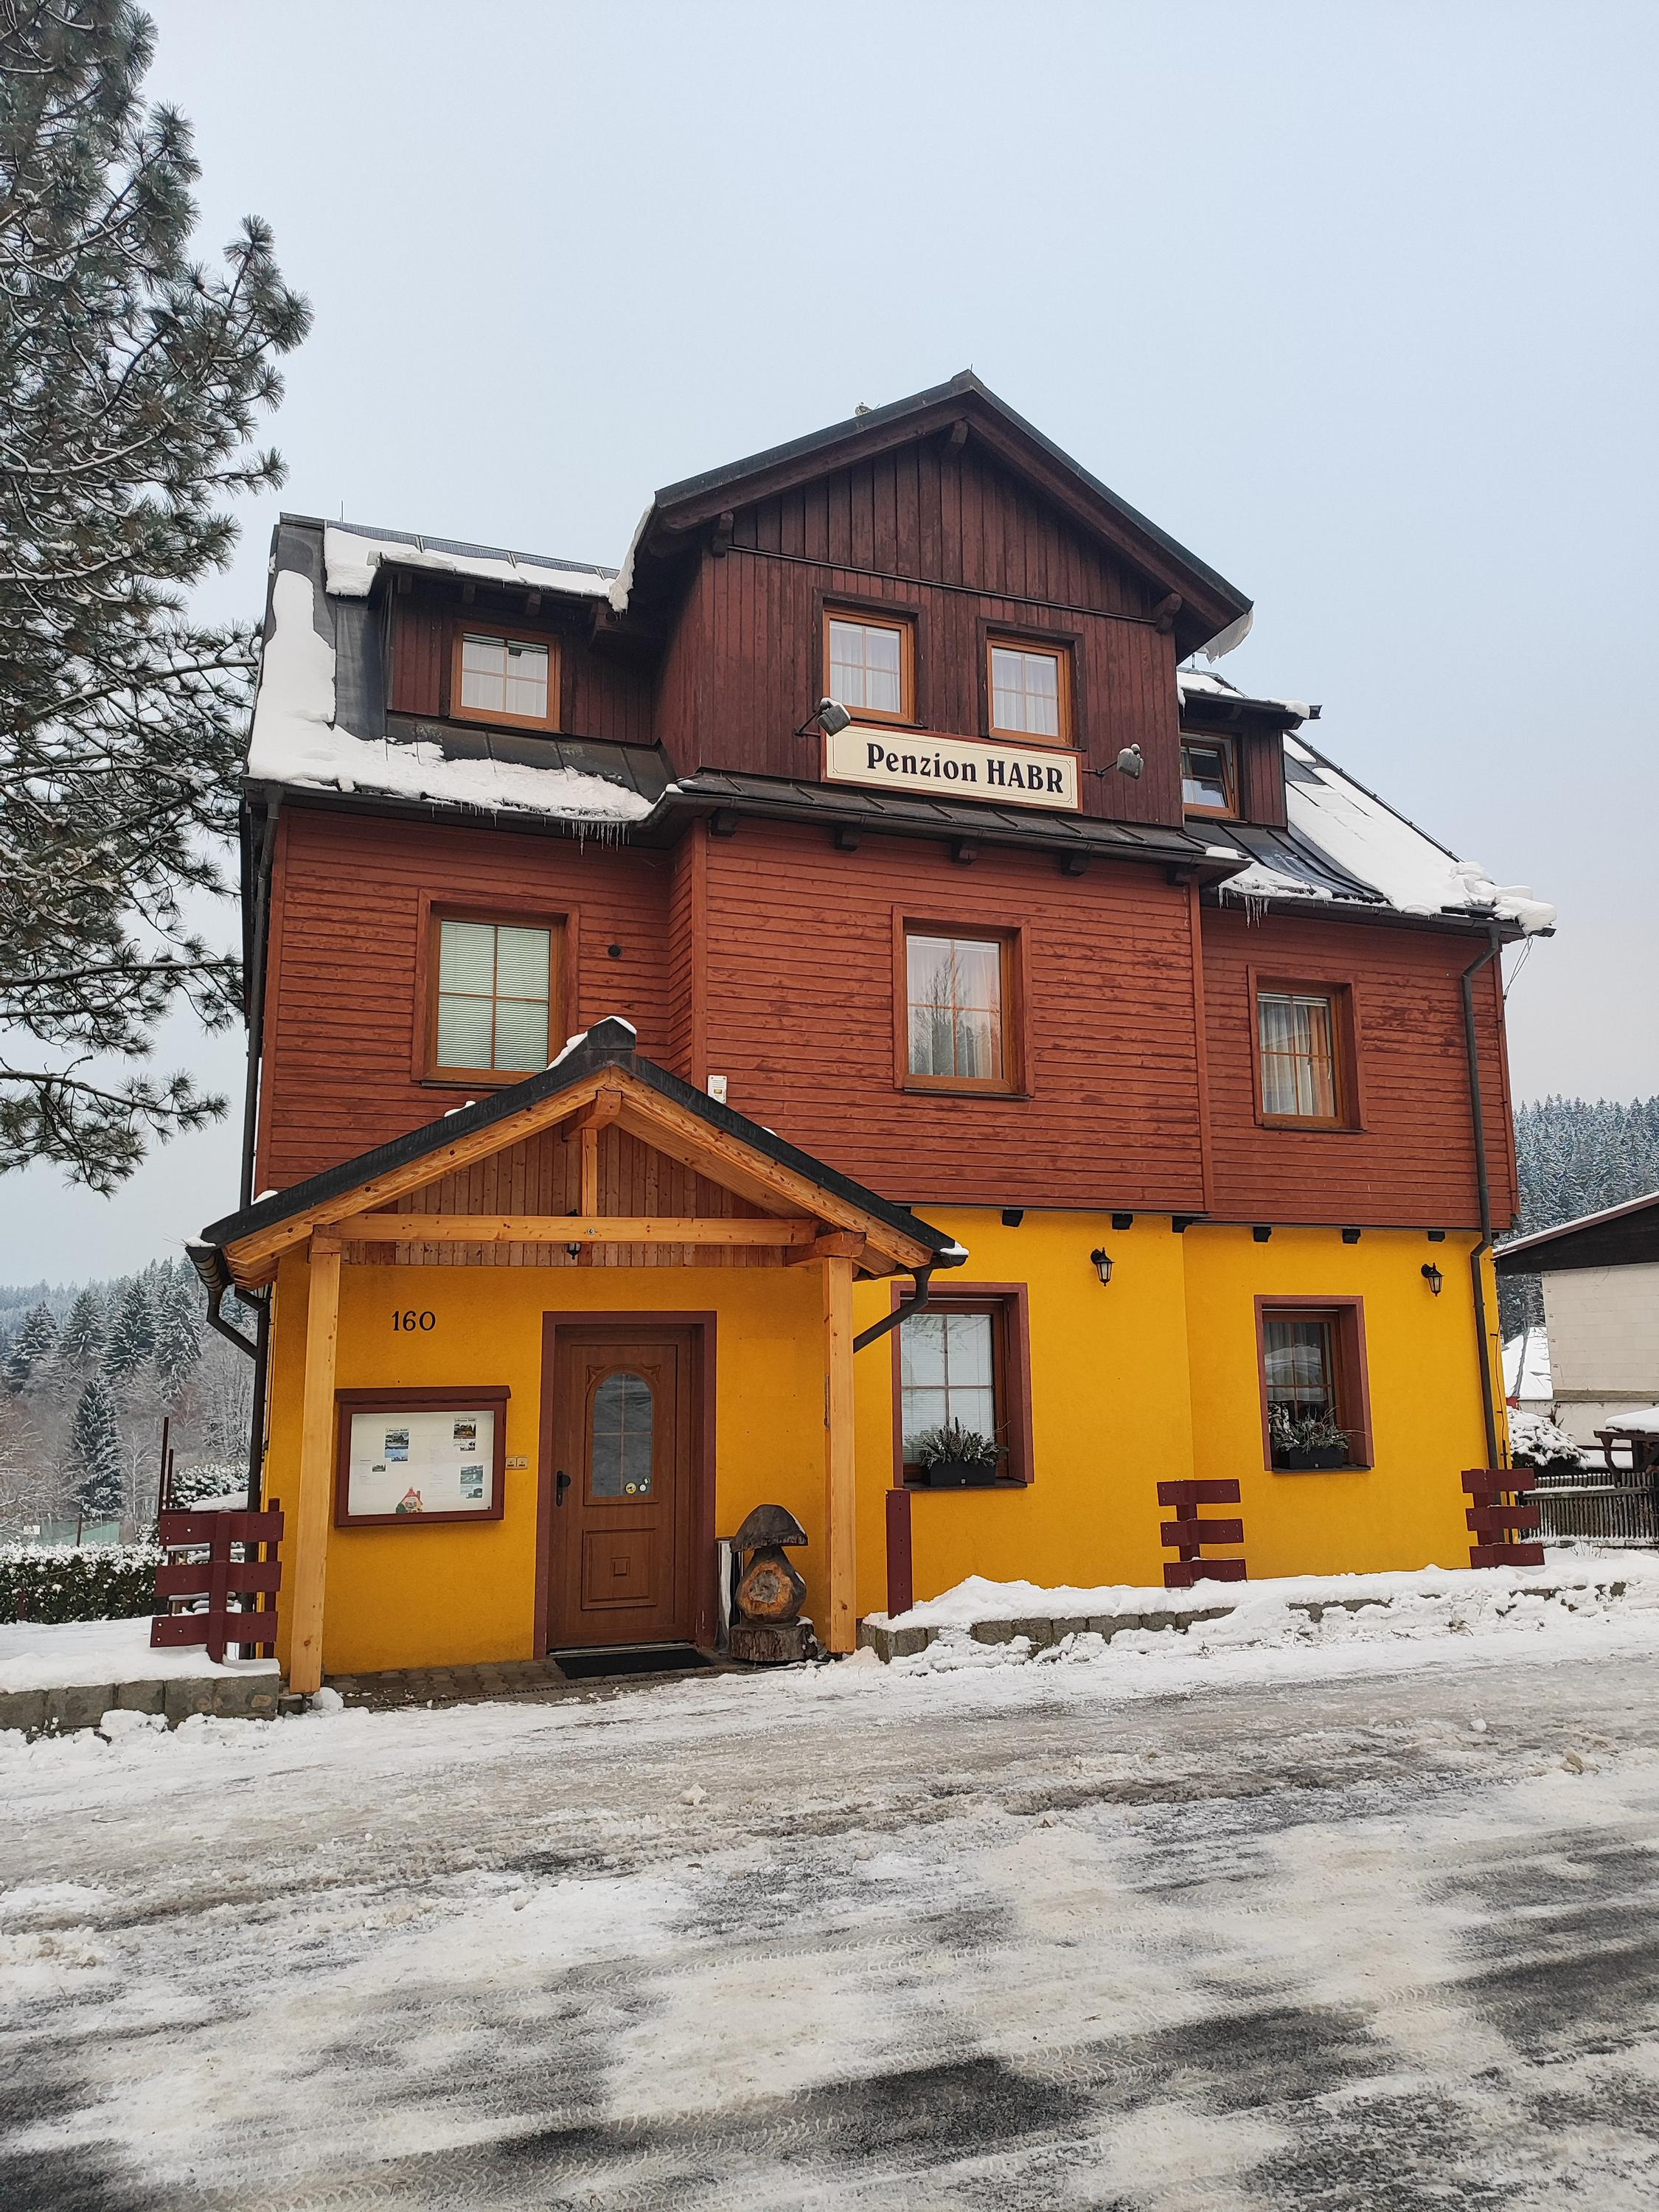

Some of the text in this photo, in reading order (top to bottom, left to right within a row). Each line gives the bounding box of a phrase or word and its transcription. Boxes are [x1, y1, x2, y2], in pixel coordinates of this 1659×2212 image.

[866, 742, 1064, 793] Penzion HABR
[391, 1310, 436, 1331] 160
